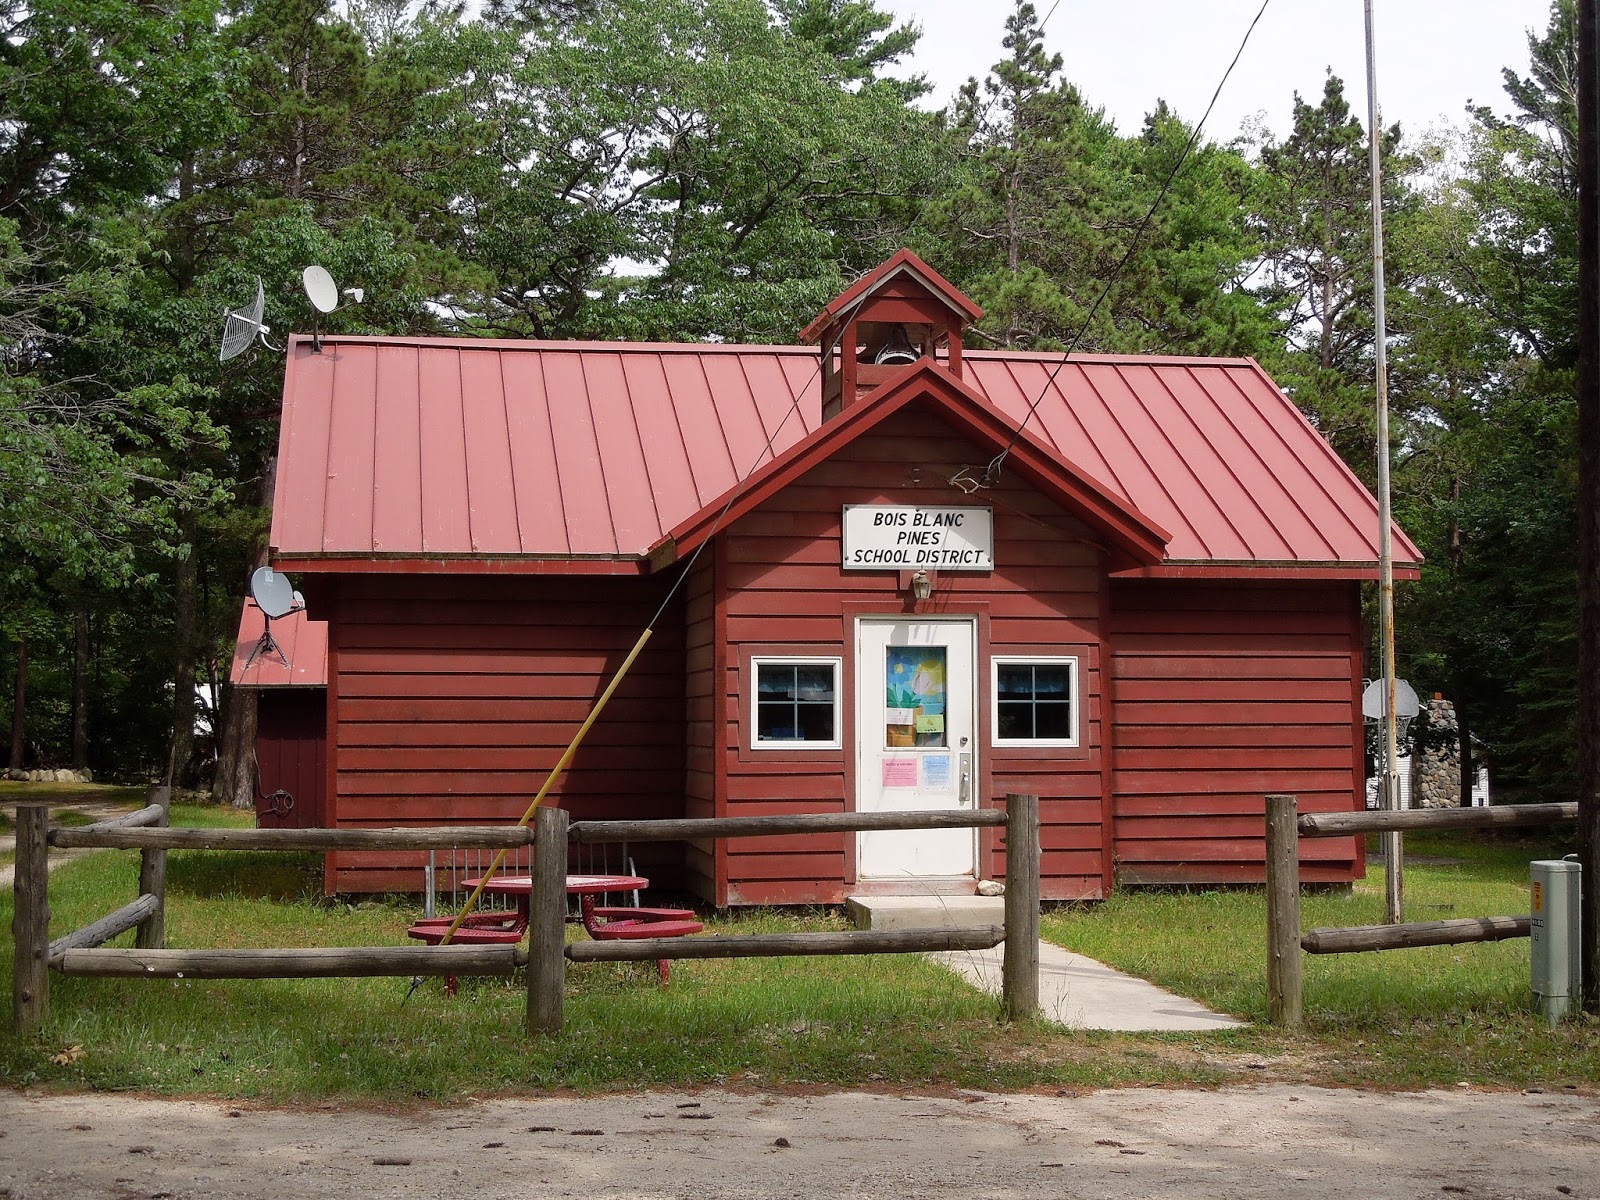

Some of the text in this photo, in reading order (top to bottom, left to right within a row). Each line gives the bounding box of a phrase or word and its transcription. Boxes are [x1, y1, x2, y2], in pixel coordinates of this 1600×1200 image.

[874, 512, 964, 527] BOIS BLANC
[897, 531, 941, 545] PINES
[854, 549, 984, 564] SCHOOL DISTRICT
